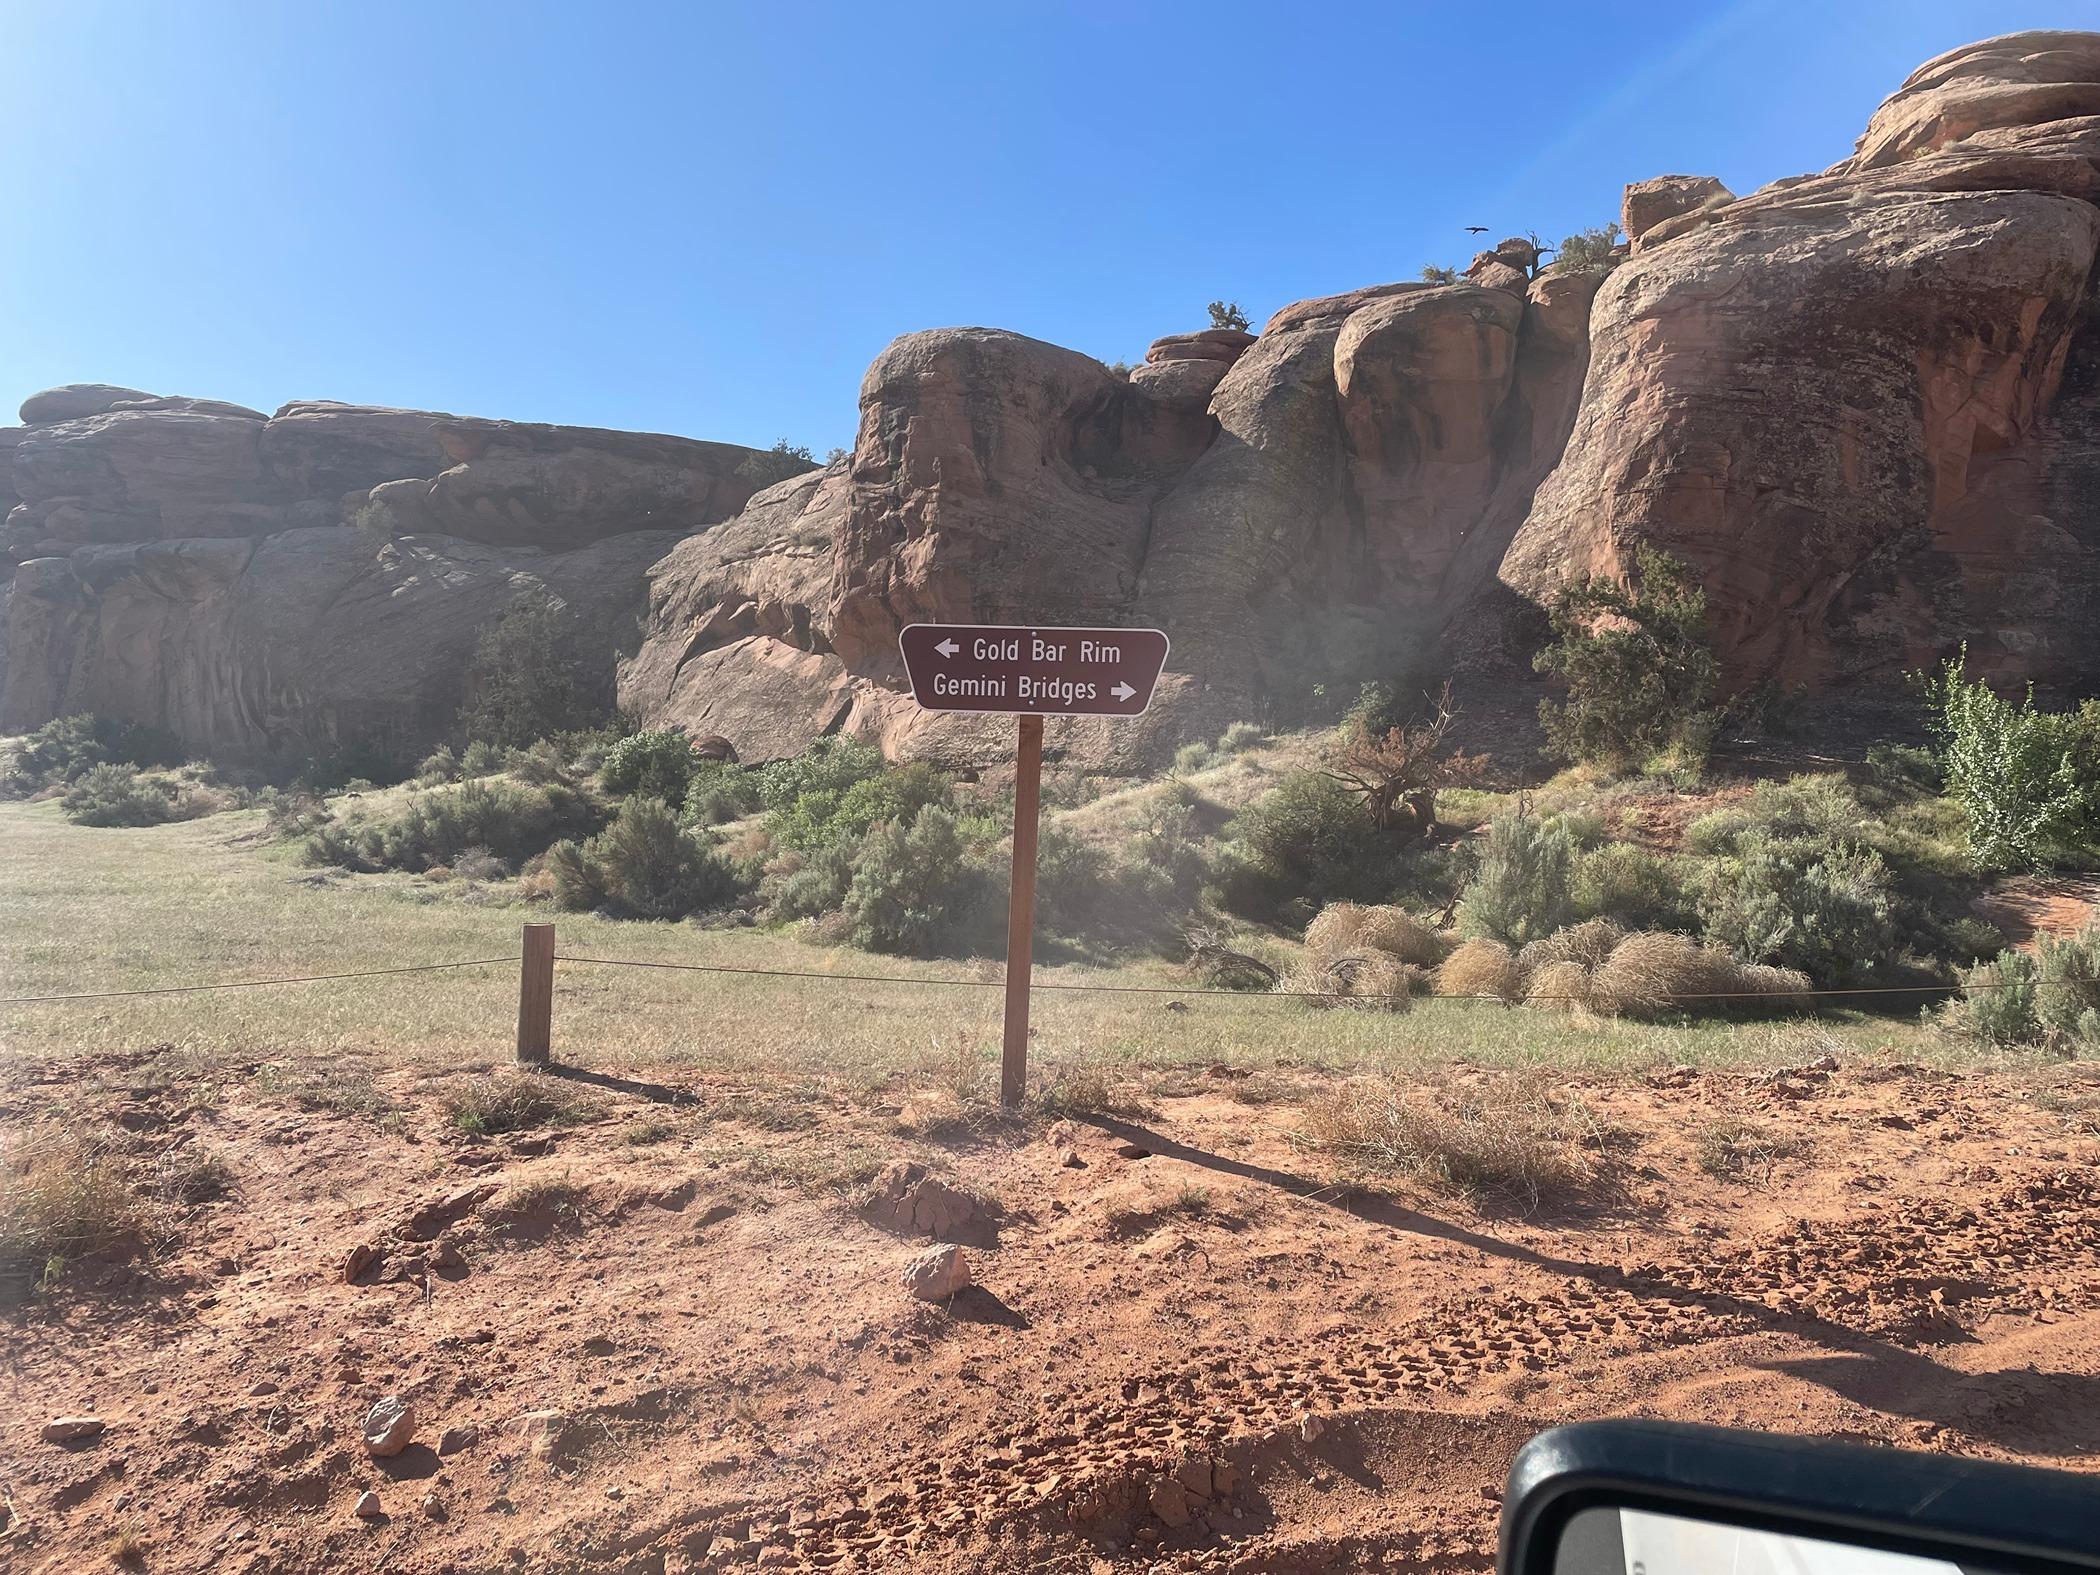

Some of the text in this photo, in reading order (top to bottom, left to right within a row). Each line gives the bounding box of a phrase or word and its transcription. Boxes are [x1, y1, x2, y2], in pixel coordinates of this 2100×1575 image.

[973, 638, 1121, 663] Gold Bar Rim
[933, 673, 1097, 705] Gemini Bridges
